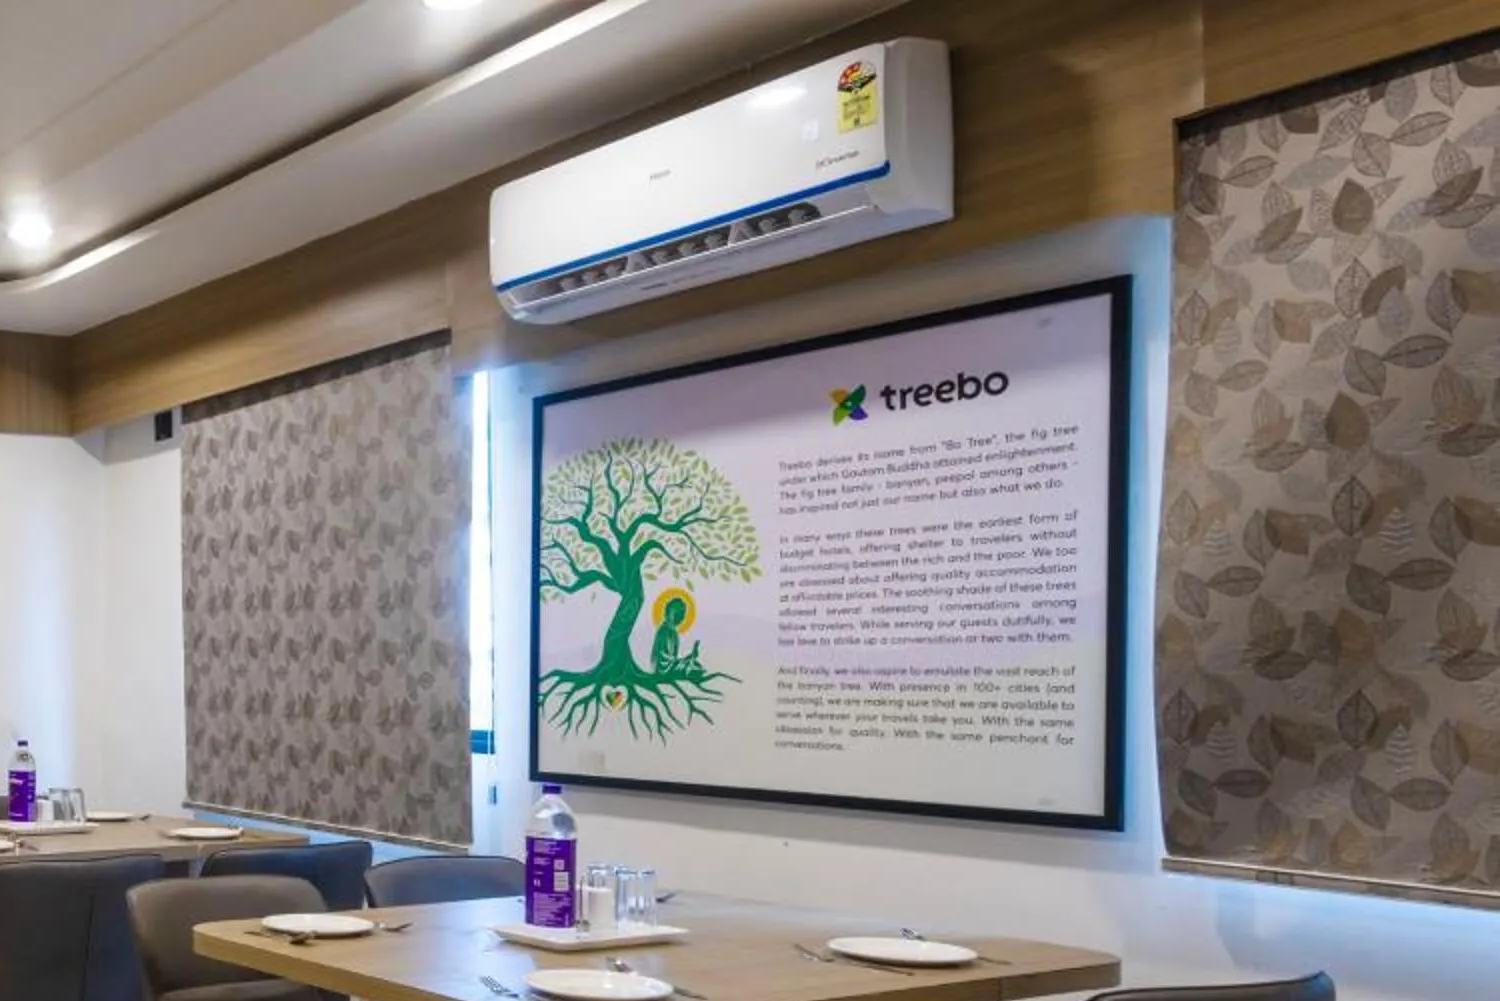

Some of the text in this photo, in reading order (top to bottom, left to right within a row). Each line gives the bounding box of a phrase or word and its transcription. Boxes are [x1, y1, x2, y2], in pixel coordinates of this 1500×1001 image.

[879, 370, 1009, 411] treebo
[779, 462, 812, 471] Treebo
[910, 443, 937, 454] from
[1005, 432, 1026, 443] the
[1053, 425, 1079, 437] tree
[779, 476, 806, 486] under
[810, 471, 839, 482] which
[887, 461, 930, 473] Buddha
[933, 454, 982, 469] attained
[980, 466, 1023, 479] among
[1028, 460, 1068, 473] others
[904, 492, 936, 503] name
[961, 487, 986, 497] also
[989, 483, 1020, 494] what
[855, 529, 884, 538] these
[890, 527, 916, 536] trees
[922, 522, 948, 533] were
[1029, 514, 1059, 524] form
[780, 549, 814, 560] budget
[860, 543, 900, 553] offering
[908, 539, 944, 550] shelter
[971, 534, 1023, 545] travelers
[1030, 529, 1077, 541] without
[852, 558, 898, 569] between
[922, 554, 944, 564] rich
[948, 552, 971, 563] and
[1032, 547, 1052, 557] We
[1055, 547, 1077, 556] too
[848, 575, 880, 585] about
[884, 571, 926, 583] offering
[931, 570, 970, 581] quality
[975, 563, 1077, 578] accommodation
[906, 586, 953, 597] soothing
[956, 584, 991, 595] shade
[1010, 582, 1043, 592] these
[1046, 581, 1076, 590] trees
[871, 605, 928, 614] interesting
[939, 600, 1020, 611] conversations
[1032, 599, 1076, 610] among
[860, 620, 890, 629] While
[894, 620, 934, 631] serving
[960, 617, 998, 628] guests
[891, 634, 963, 644] conversation
[981, 634, 1004, 643] two
[1007, 632, 1033, 642] with
[995, 667, 1021, 676] vast
[1024, 666, 1060, 677] reach
[869, 682, 895, 691] With
[900, 683, 950, 693] presence
[1008, 684, 1040, 693] cities
[863, 697, 903, 708] making
[907, 699, 928, 707] sure
[932, 699, 955, 709] that
[1001, 699, 1058, 710] available
[855, 714, 878, 723] your
[882, 713, 918, 723] travels
[922, 715, 947, 724] take
[981, 715, 1009, 726] With
[1014, 717, 1034, 727] the
[1040, 718, 1074, 727] same
[893, 728, 920, 738] With
[950, 732, 983, 742] same
[989, 733, 1048, 745] penchant
